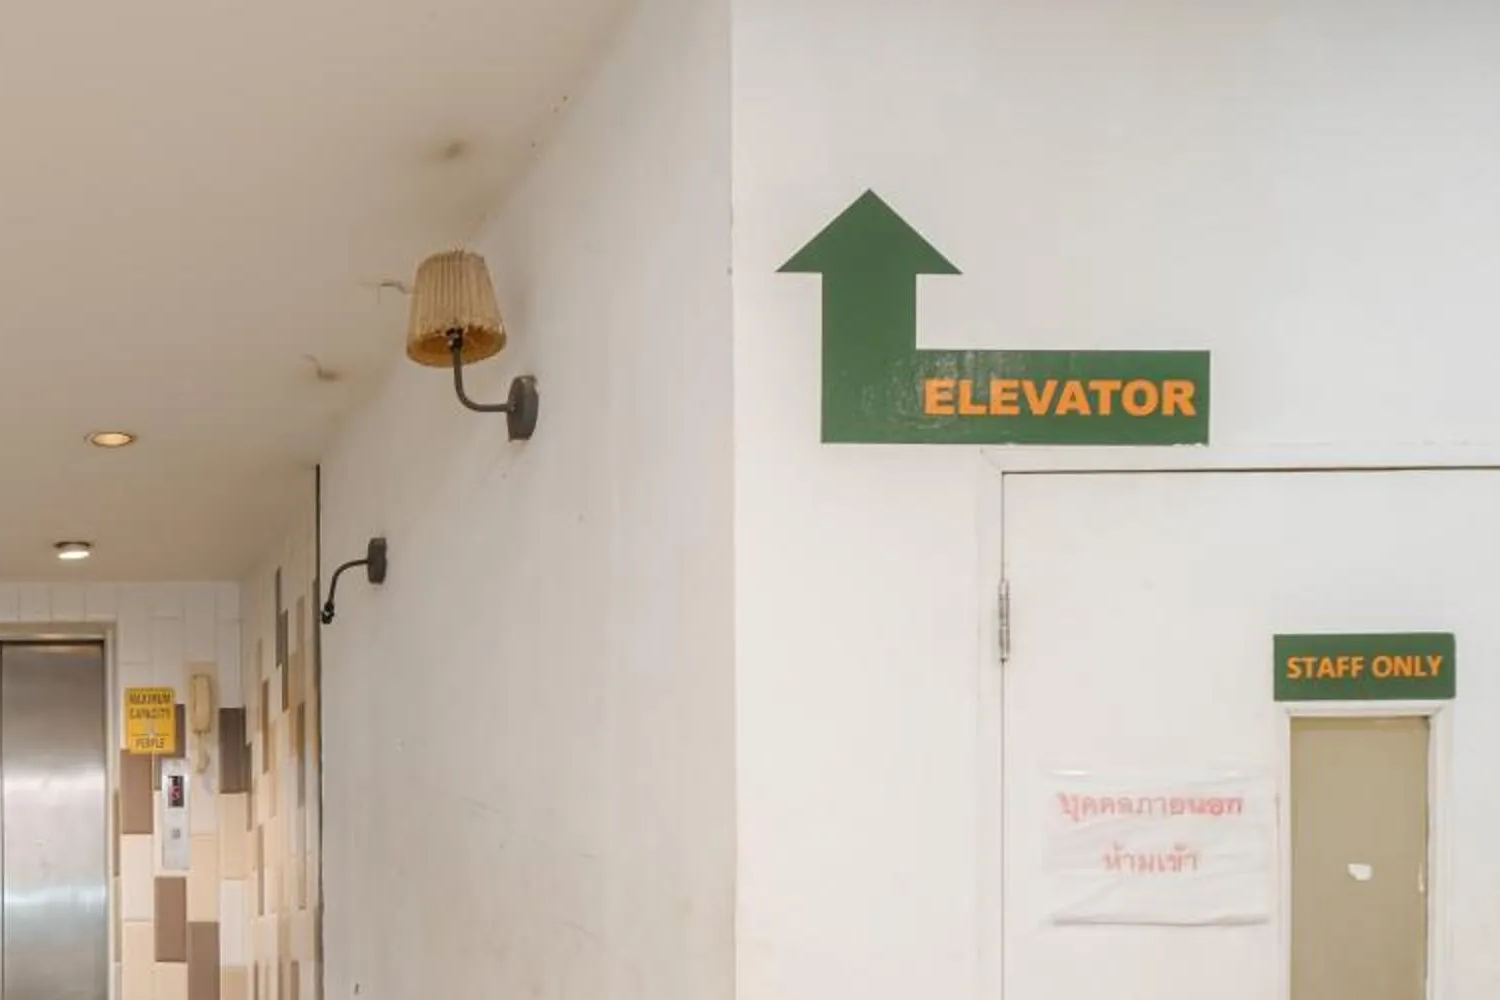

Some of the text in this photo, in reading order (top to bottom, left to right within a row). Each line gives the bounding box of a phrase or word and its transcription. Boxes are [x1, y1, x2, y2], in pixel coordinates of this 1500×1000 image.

[923, 378, 1197, 417] ELEVATOR
[1286, 654, 1443, 680] STAFF ONLY
